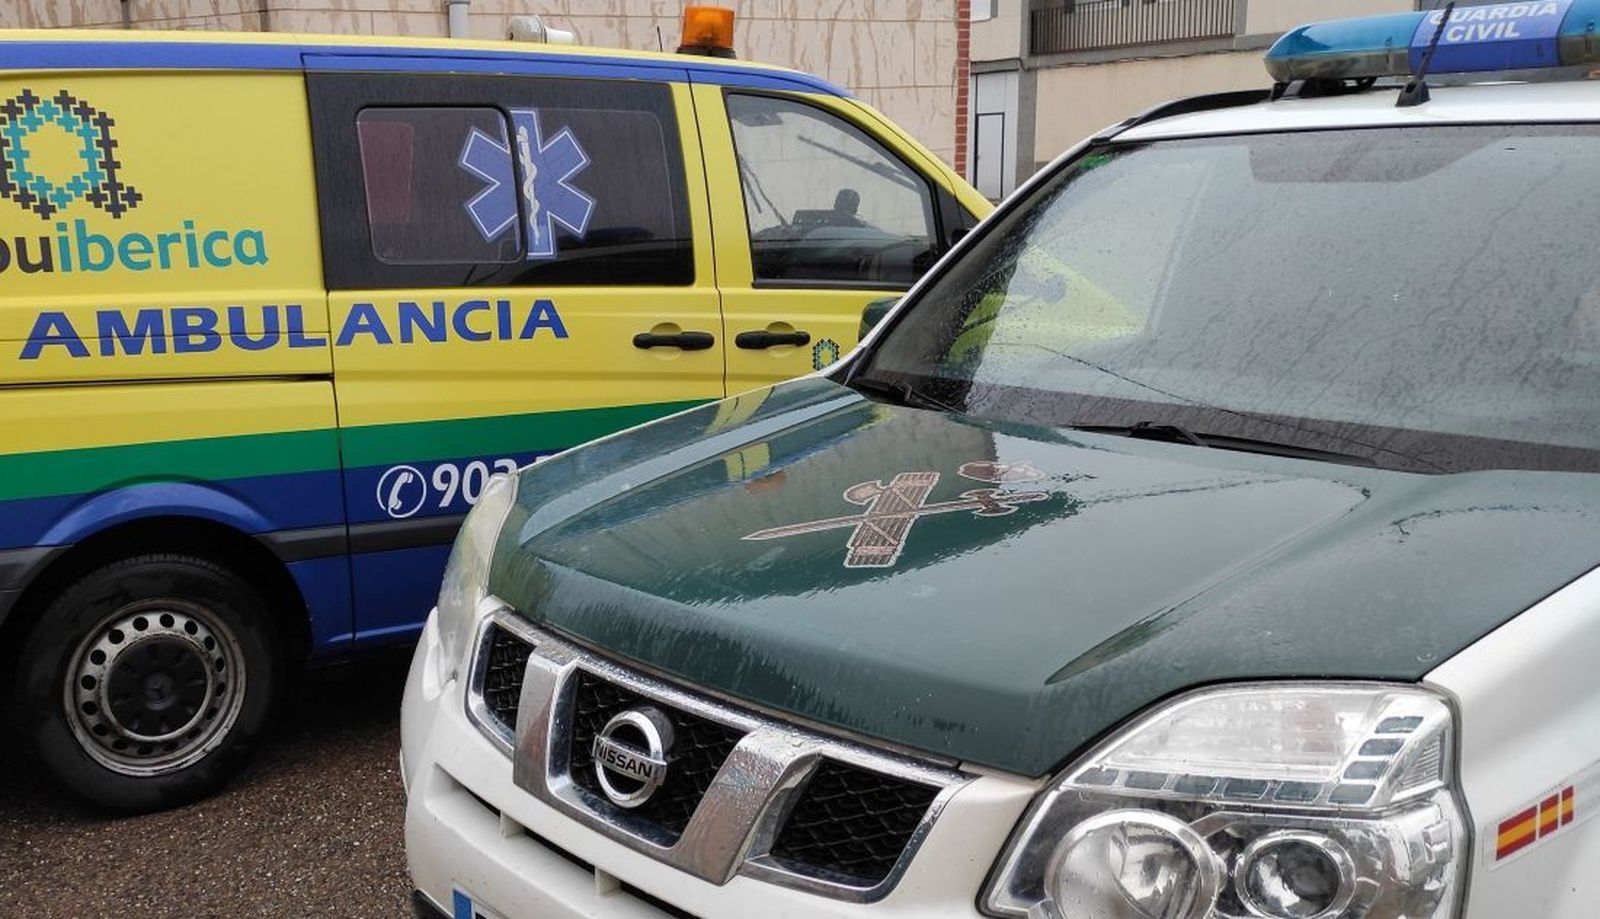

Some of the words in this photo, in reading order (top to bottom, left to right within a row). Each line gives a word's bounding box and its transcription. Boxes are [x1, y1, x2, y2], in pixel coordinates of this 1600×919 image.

[1446, 22, 1520, 42] CIVIL
[19, 299, 569, 360] AMBULANCIA
[595, 741, 653, 778] NISSAN
